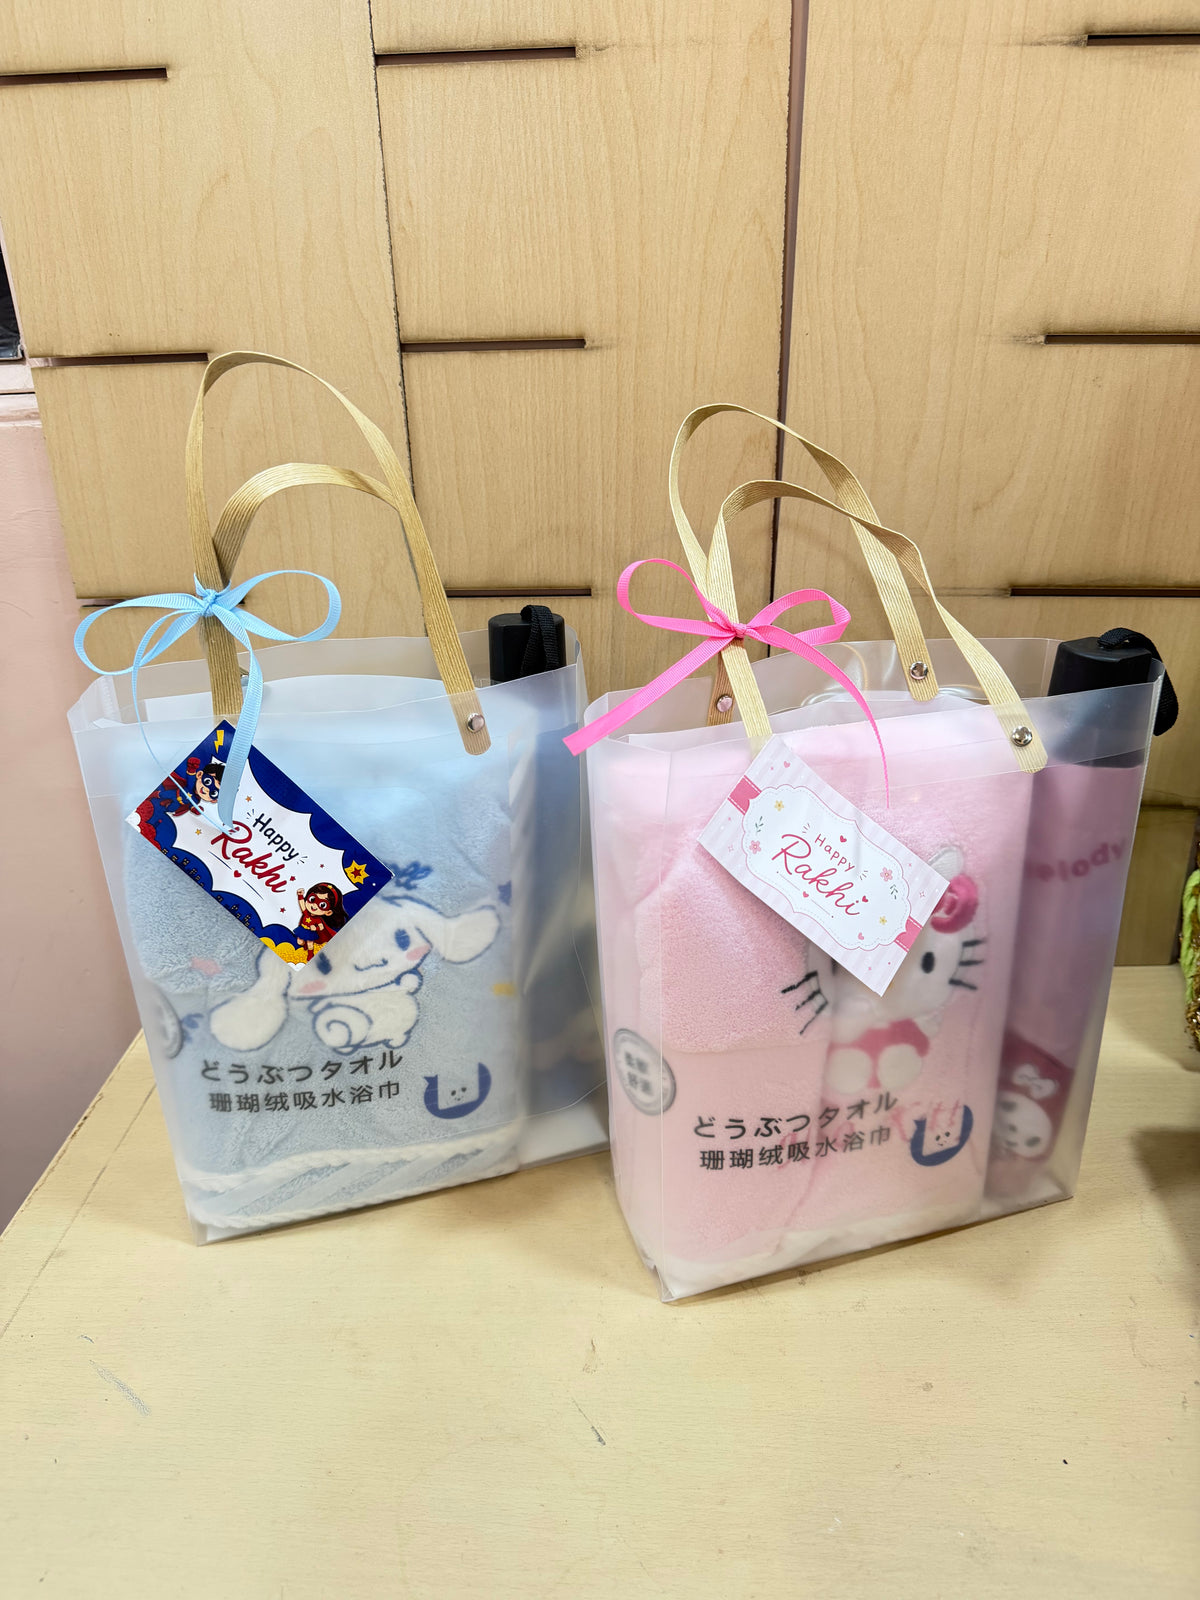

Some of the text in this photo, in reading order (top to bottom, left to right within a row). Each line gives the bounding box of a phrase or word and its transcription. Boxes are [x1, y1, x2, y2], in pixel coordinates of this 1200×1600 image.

[210, 820, 290, 894] Rakhi
[254, 812, 300, 861] Happy
[814, 833, 855, 872] Happy
[771, 833, 861, 915] Rakhi
[200, 1050, 403, 1085] どうぶつタオル
[208, 1080, 401, 1113] 珊瑚绒吸水浴巾
[693, 1092, 898, 1139] どうぶつタオル
[699, 1125, 892, 1171] 珊瑚绒吸水浴巾
